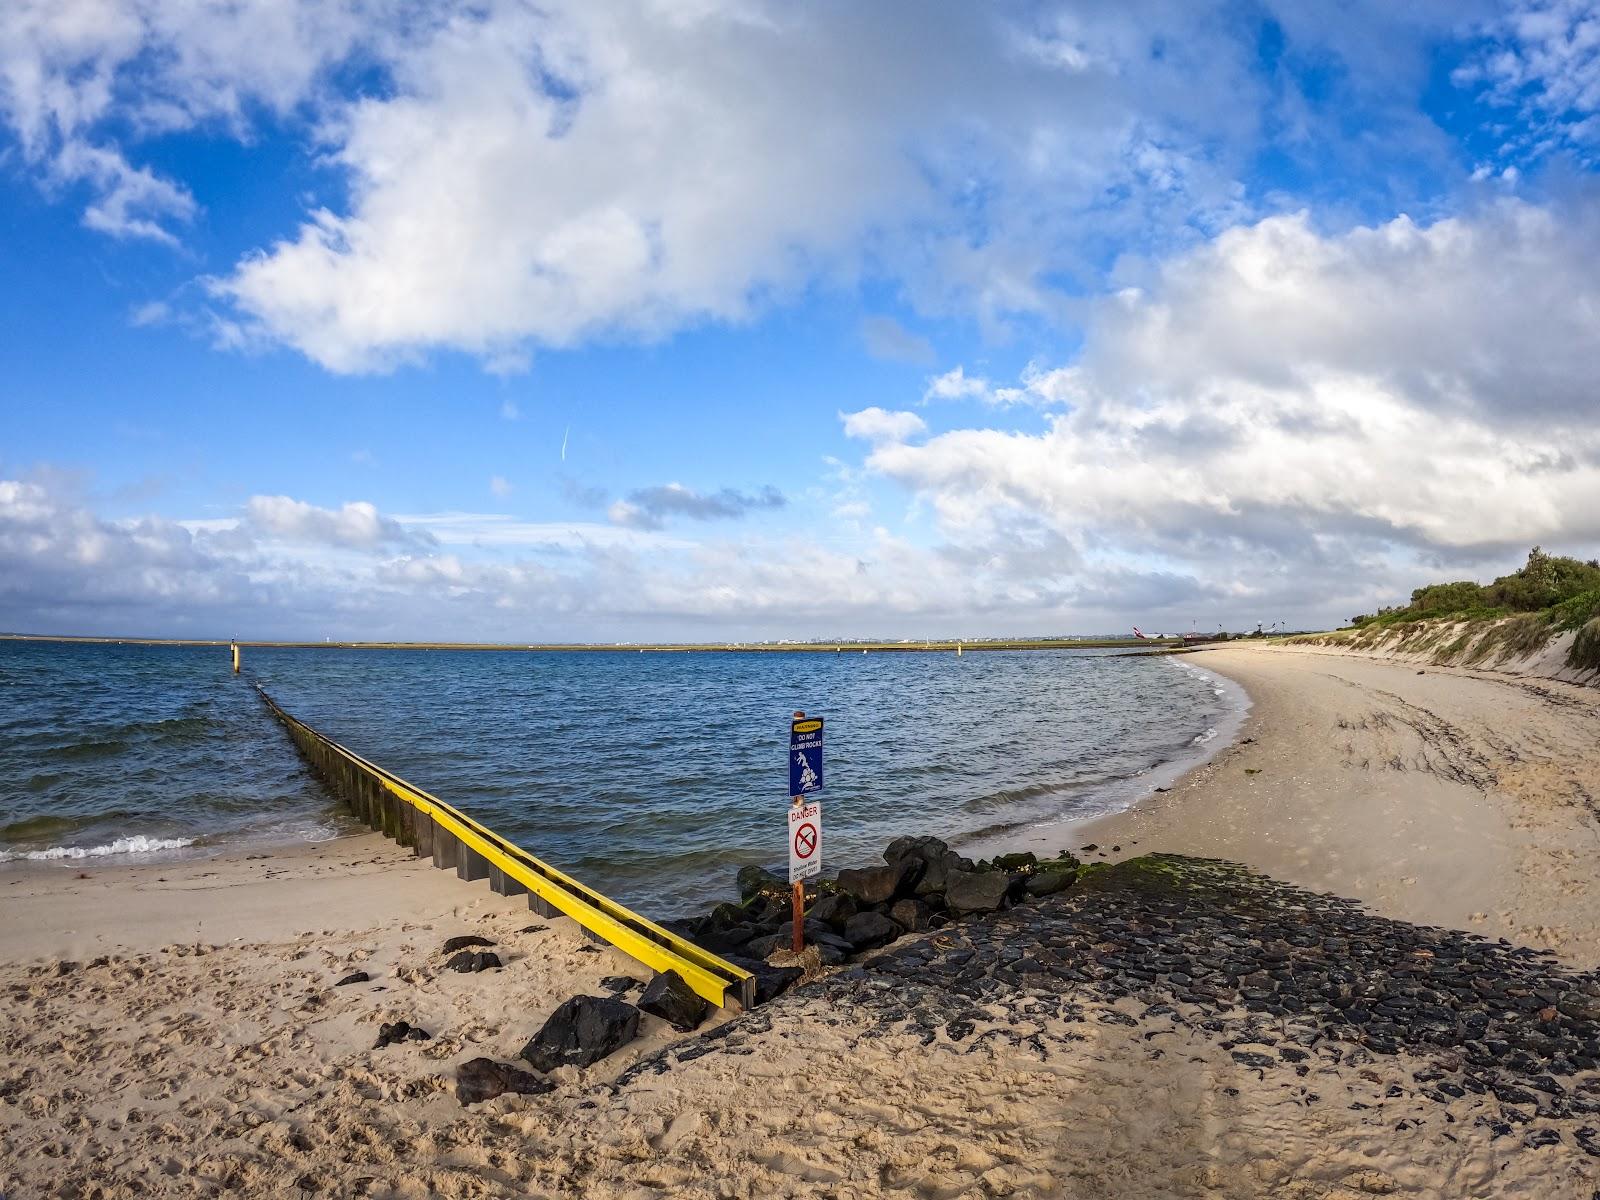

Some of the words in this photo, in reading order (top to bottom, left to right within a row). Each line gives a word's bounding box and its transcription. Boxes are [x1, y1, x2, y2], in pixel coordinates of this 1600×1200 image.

[791, 742, 805, 751] CLIMB
[792, 806, 818, 822] DANGER
[794, 864, 807, 872] Shallow
